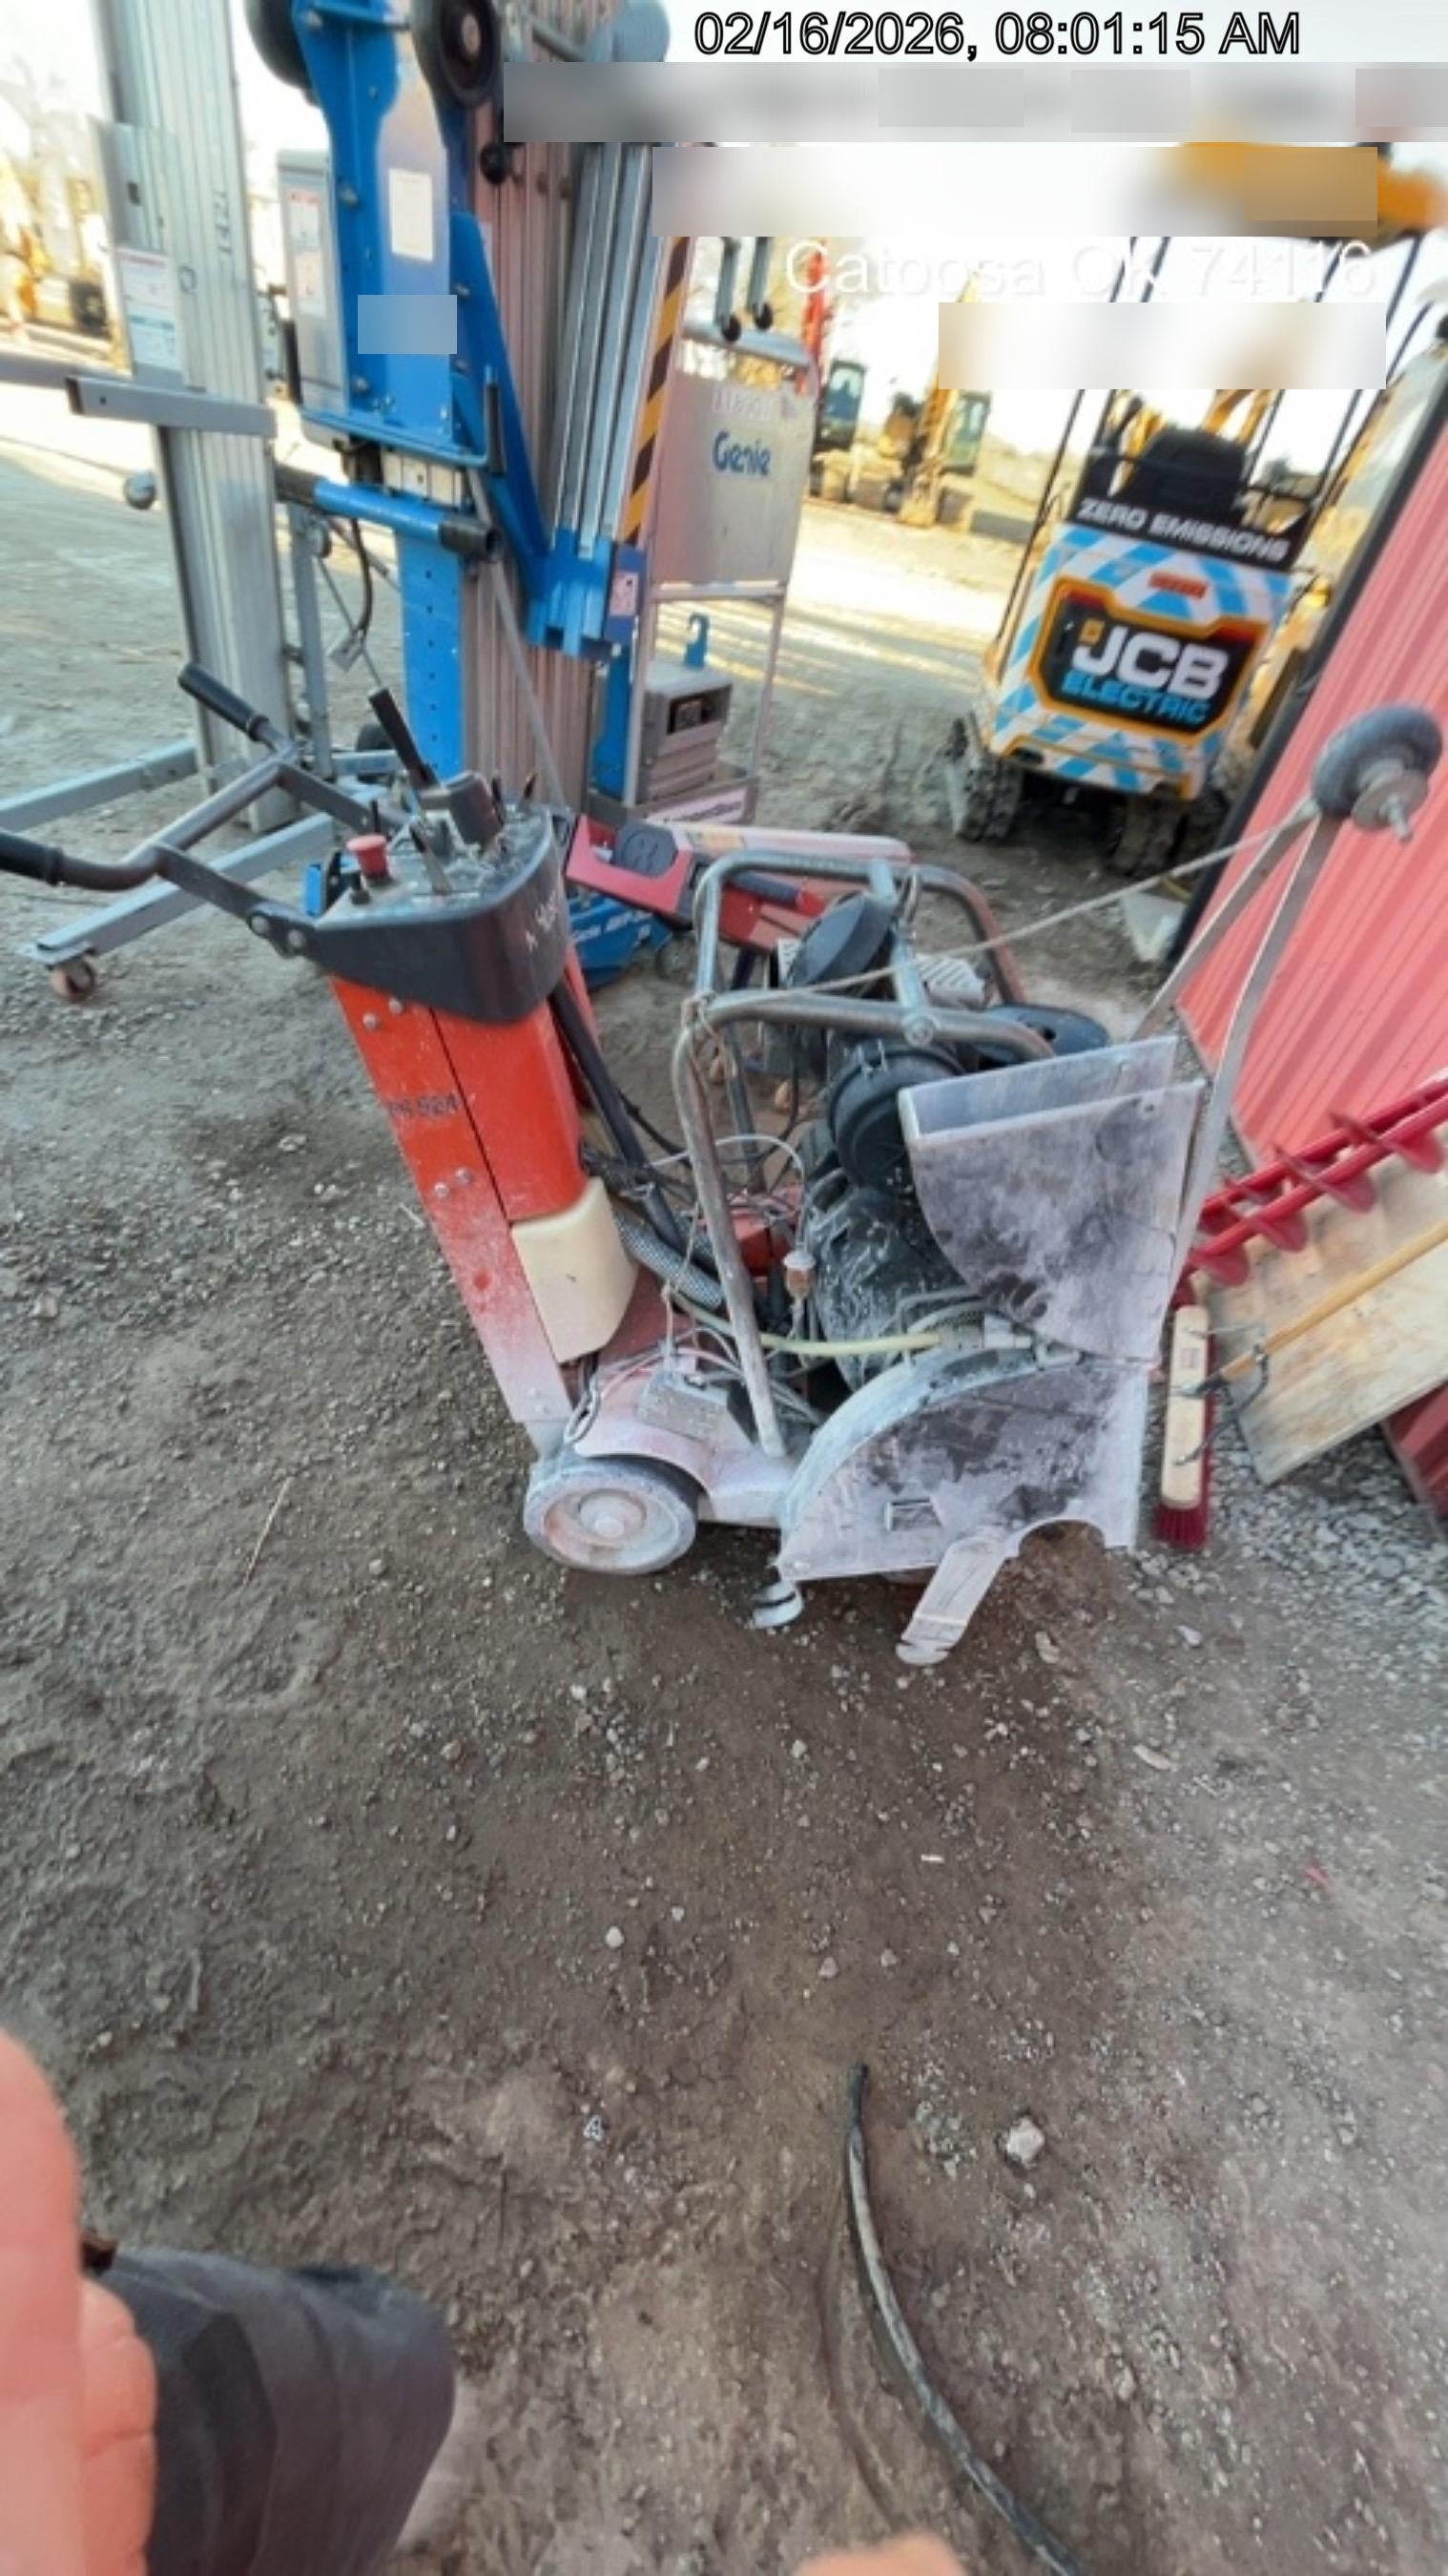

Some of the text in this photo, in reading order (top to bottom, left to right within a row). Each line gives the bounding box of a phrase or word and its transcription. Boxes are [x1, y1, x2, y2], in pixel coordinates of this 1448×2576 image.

[713, 430, 771, 475] Genie
[1077, 497, 1292, 563] ZERO EMISSIONS
[1071, 625, 1229, 701] JCB
[1060, 670, 1212, 725] ELECTRIC
